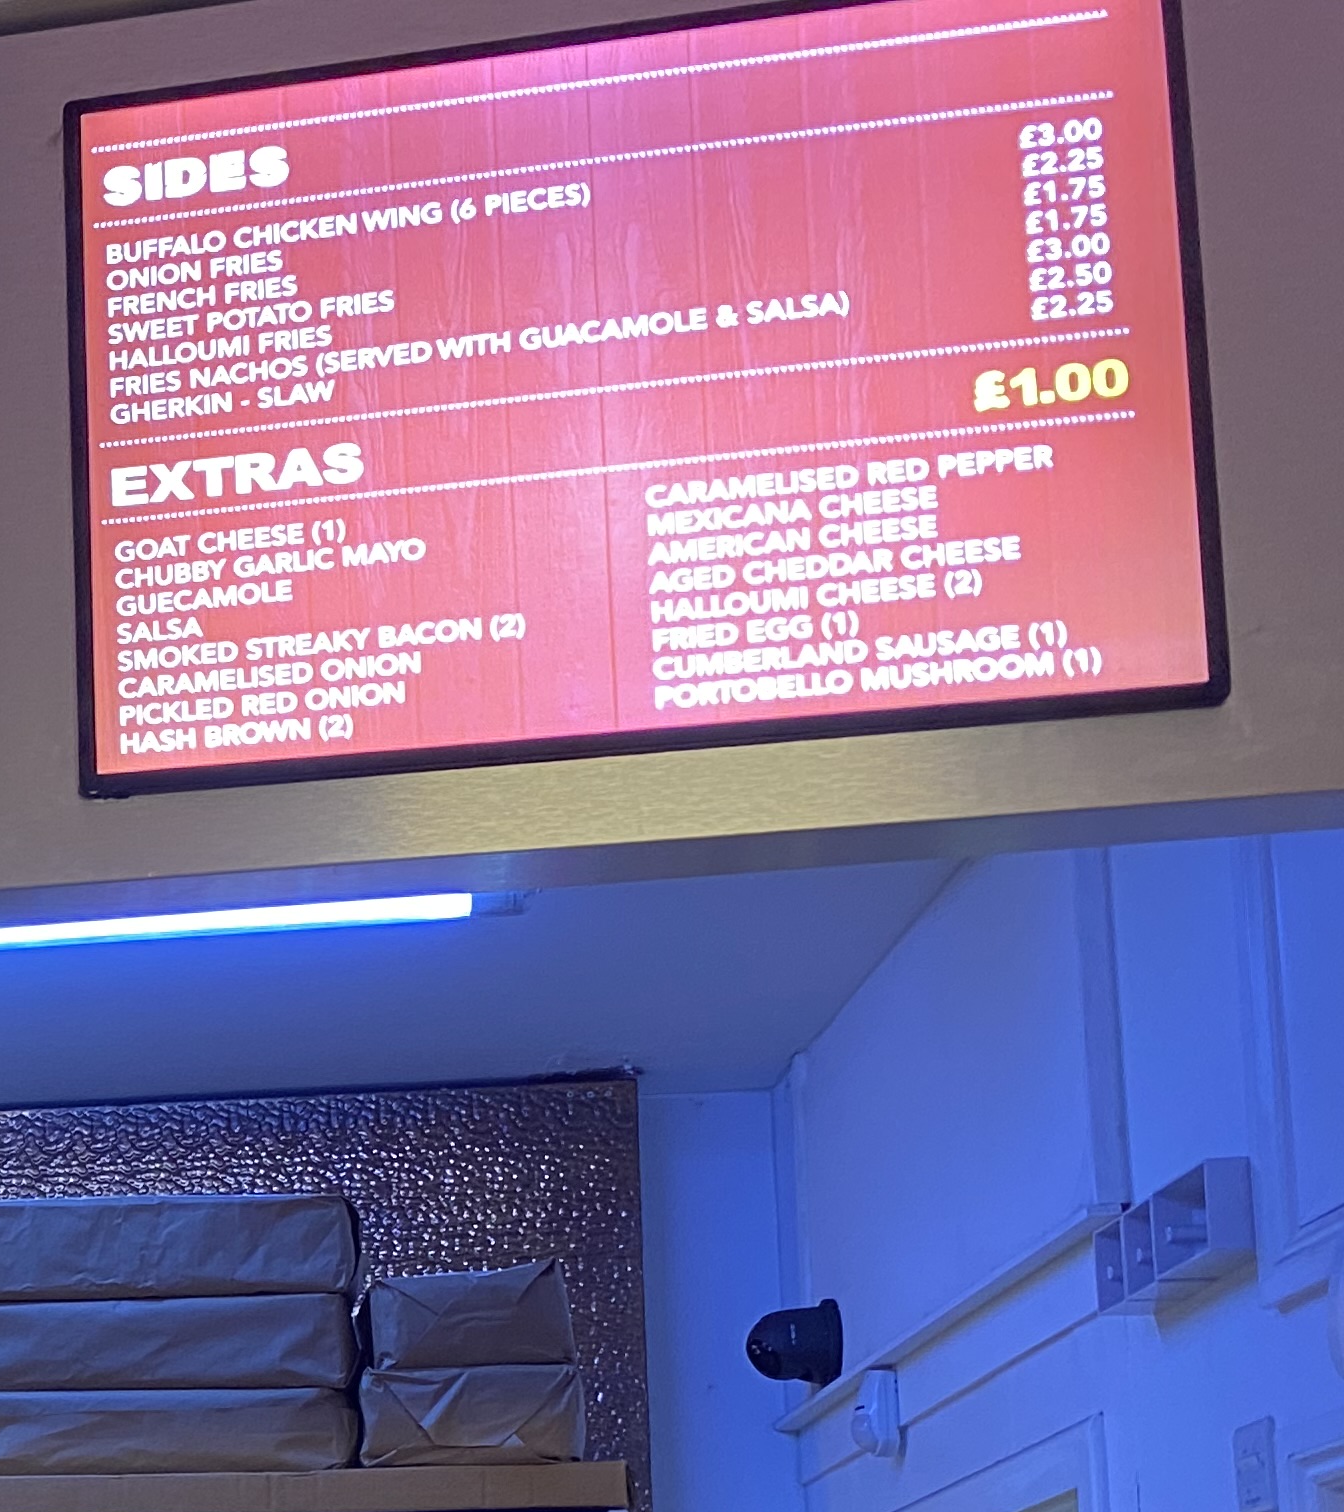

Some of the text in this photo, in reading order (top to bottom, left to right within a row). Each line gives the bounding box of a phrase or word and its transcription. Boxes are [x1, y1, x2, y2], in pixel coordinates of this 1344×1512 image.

[1019, 117, 1103, 149] £3.00
[103, 146, 290, 206] SIDES
[1021, 146, 1104, 178] £2.25
[1024, 174, 1106, 206] £1.75
[107, 249, 283, 291] ONION FRIES
[109, 325, 332, 371] HALLOUMI FRIES
[111, 358, 1129, 507] EXTRAS £1.00
[645, 445, 1053, 508] CARAMELISED RED PEPPER
[115, 519, 346, 562] GOAT CHEESE (1)
[116, 579, 293, 616] GUECAMOLE
[117, 617, 203, 644] SALSA
[118, 613, 525, 672] SMOKED STREAKY BACON (2)
[653, 620, 1067, 680] CUMBERLAND SAUSAGE (1)
